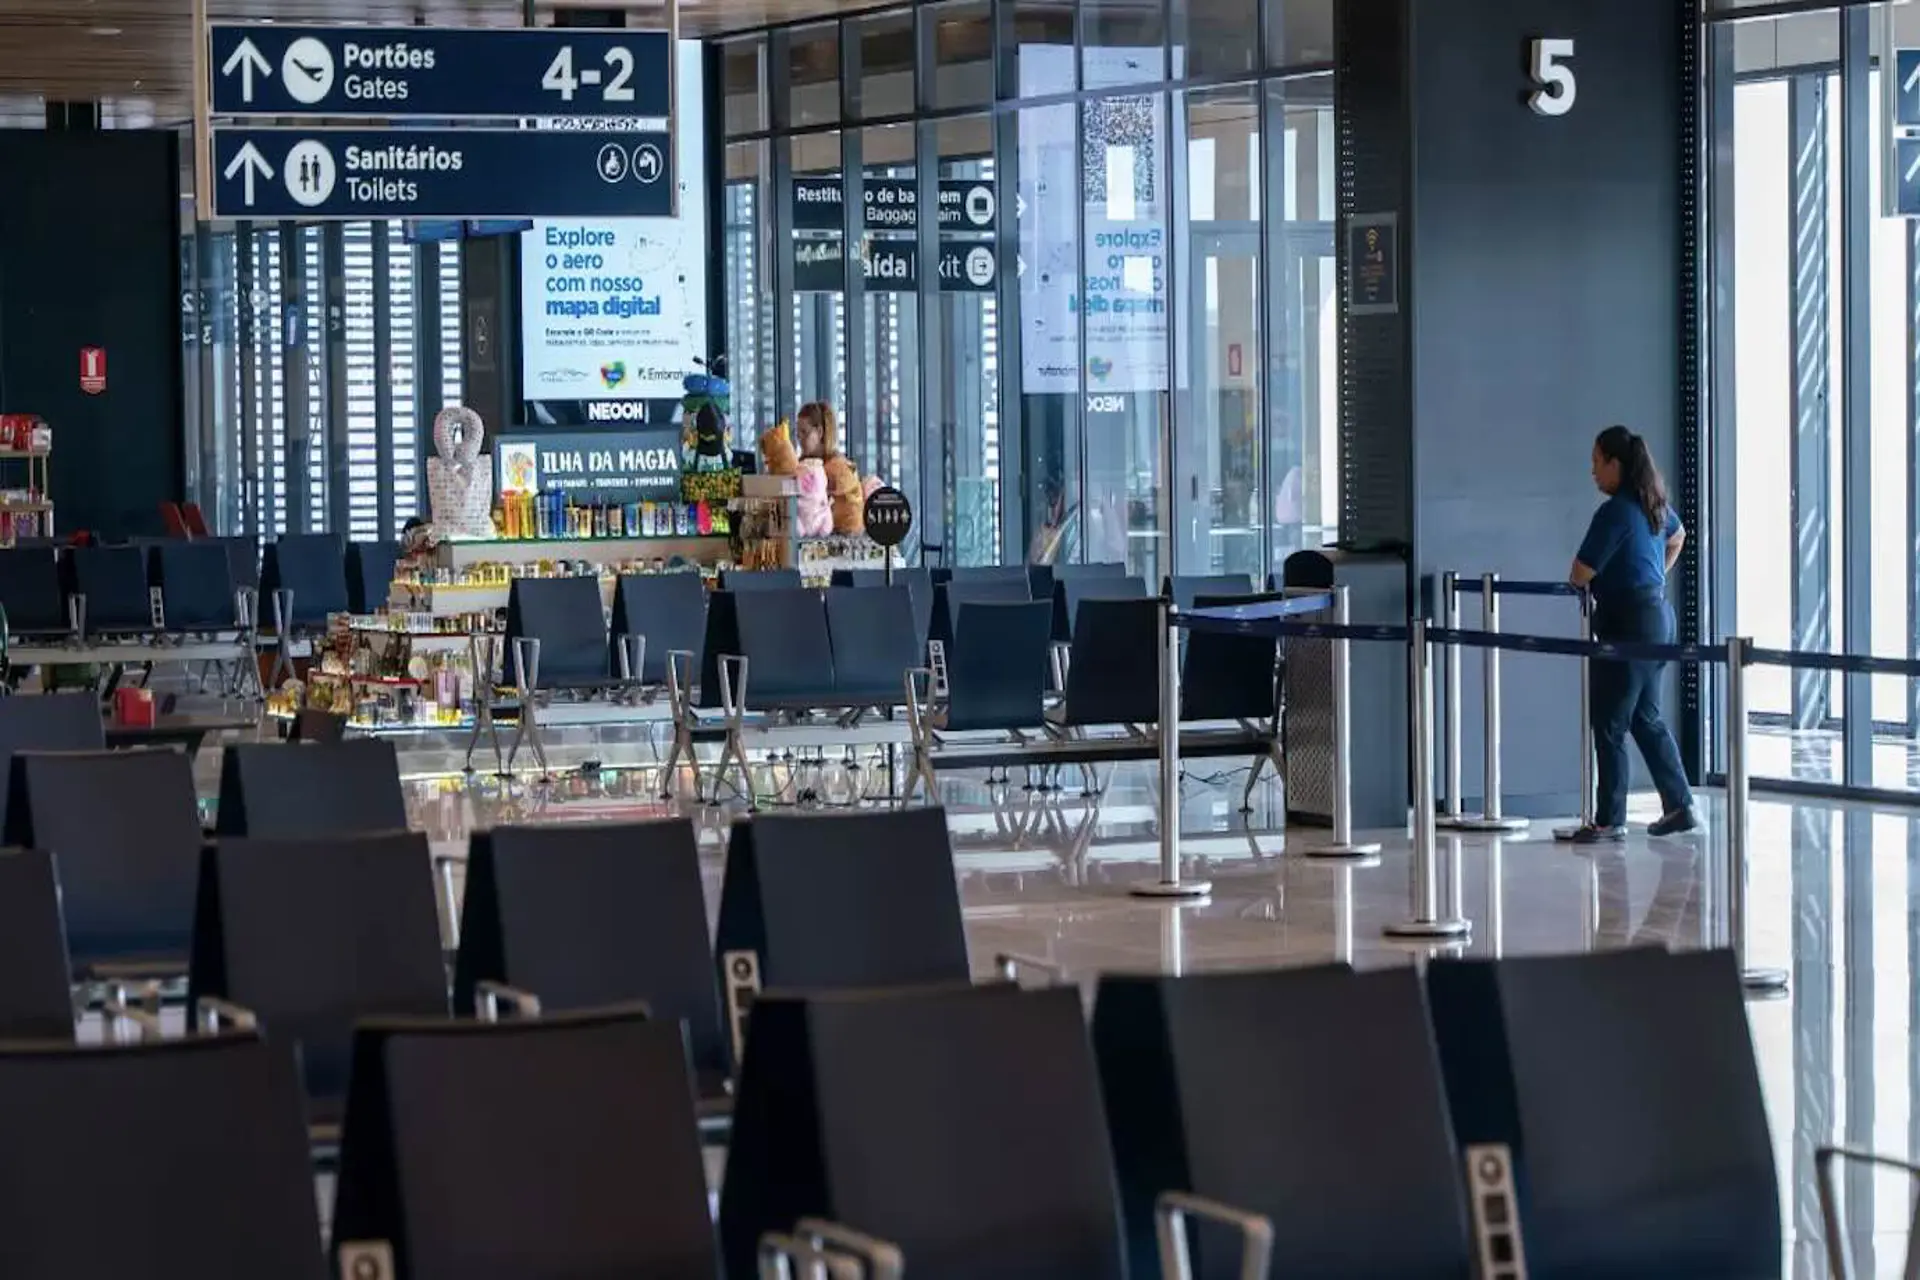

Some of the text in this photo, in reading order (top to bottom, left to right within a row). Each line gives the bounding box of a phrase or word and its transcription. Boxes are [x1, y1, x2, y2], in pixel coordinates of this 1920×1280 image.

[344, 43, 635, 100] Portões 4-2
[1529, 38, 1577, 116] 5
[344, 76, 409, 100] Gates
[345, 146, 463, 172] Sanitários
[346, 177, 418, 202] Toilets
[877, 187, 894, 203] de
[866, 206, 917, 224] Baggag
[545, 226, 615, 248] Explore
[545, 254, 604, 269] o aero
[863, 252, 907, 278] aída
[938, 254, 962, 278] xit
[545, 276, 643, 292] com nosso
[545, 295, 661, 319] mapa digital
[588, 402, 644, 420] NEOOH
[542, 448, 678, 473] ILHA DA MAGIA
